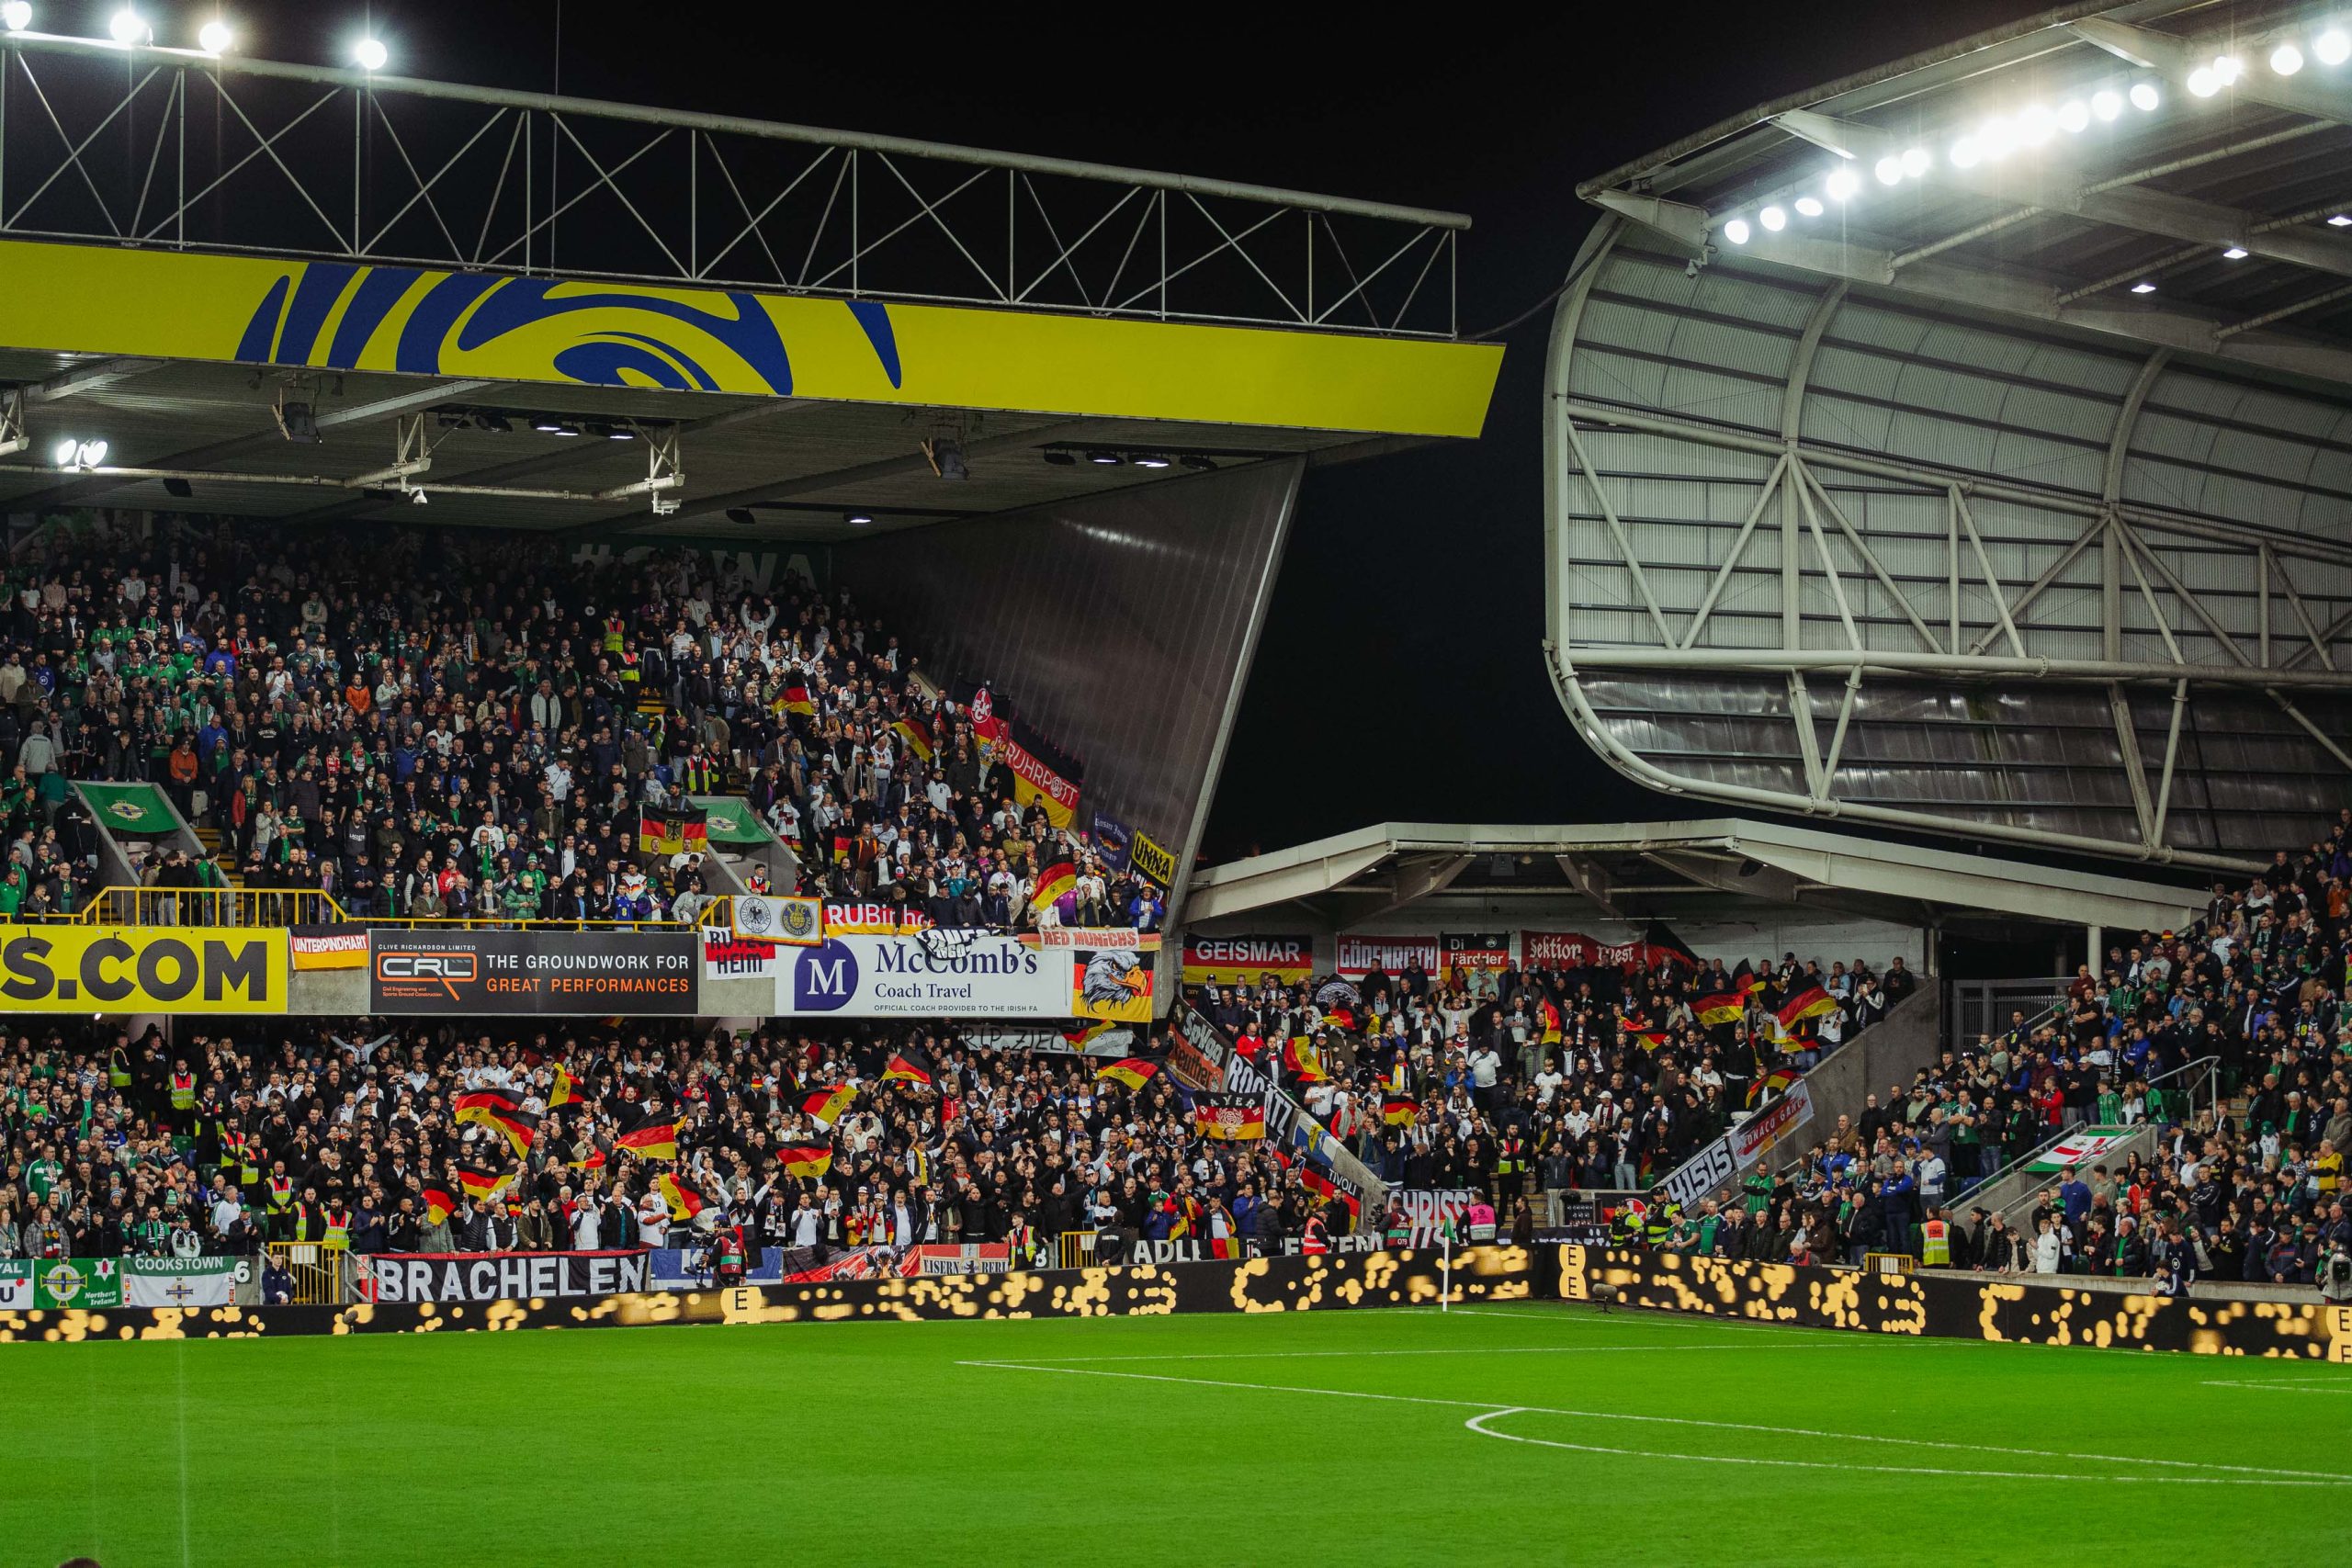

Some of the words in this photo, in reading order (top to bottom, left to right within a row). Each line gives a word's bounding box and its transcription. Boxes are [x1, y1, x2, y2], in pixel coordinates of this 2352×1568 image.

[1135, 835, 1171, 883] UNNA
[293, 935, 368, 953] UNTERPINDHART
[1042, 931, 1070, 946] RED
[1451, 938, 1464, 951] Di
[1195, 941, 1301, 963] GEISMAR
[0, 937, 267, 1002] S.COM
[382, 958, 472, 976] CRL
[486, 954, 519, 969] THE
[526, 955, 650, 969] GROUNDWORK
[656, 955, 689, 969] FOR
[717, 953, 763, 975] HEIM
[486, 978, 541, 992] GREAT
[551, 978, 689, 992] PERFORMANCES
[808, 958, 847, 996] M
[875, 983, 922, 998] Coach
[925, 983, 972, 998] Travel
[1328, 1168, 1358, 1196] TIVOLI
[1666, 1140, 1734, 1209] 41515
[135, 1256, 224, 1271] COOKSTOWN
[234, 1261, 251, 1283] 6
[923, 1258, 960, 1275] EISERN
[376, 1255, 647, 1302] BRACHELEN
[85, 1291, 117, 1300] Northern
[90, 1297, 117, 1306] Ireland
